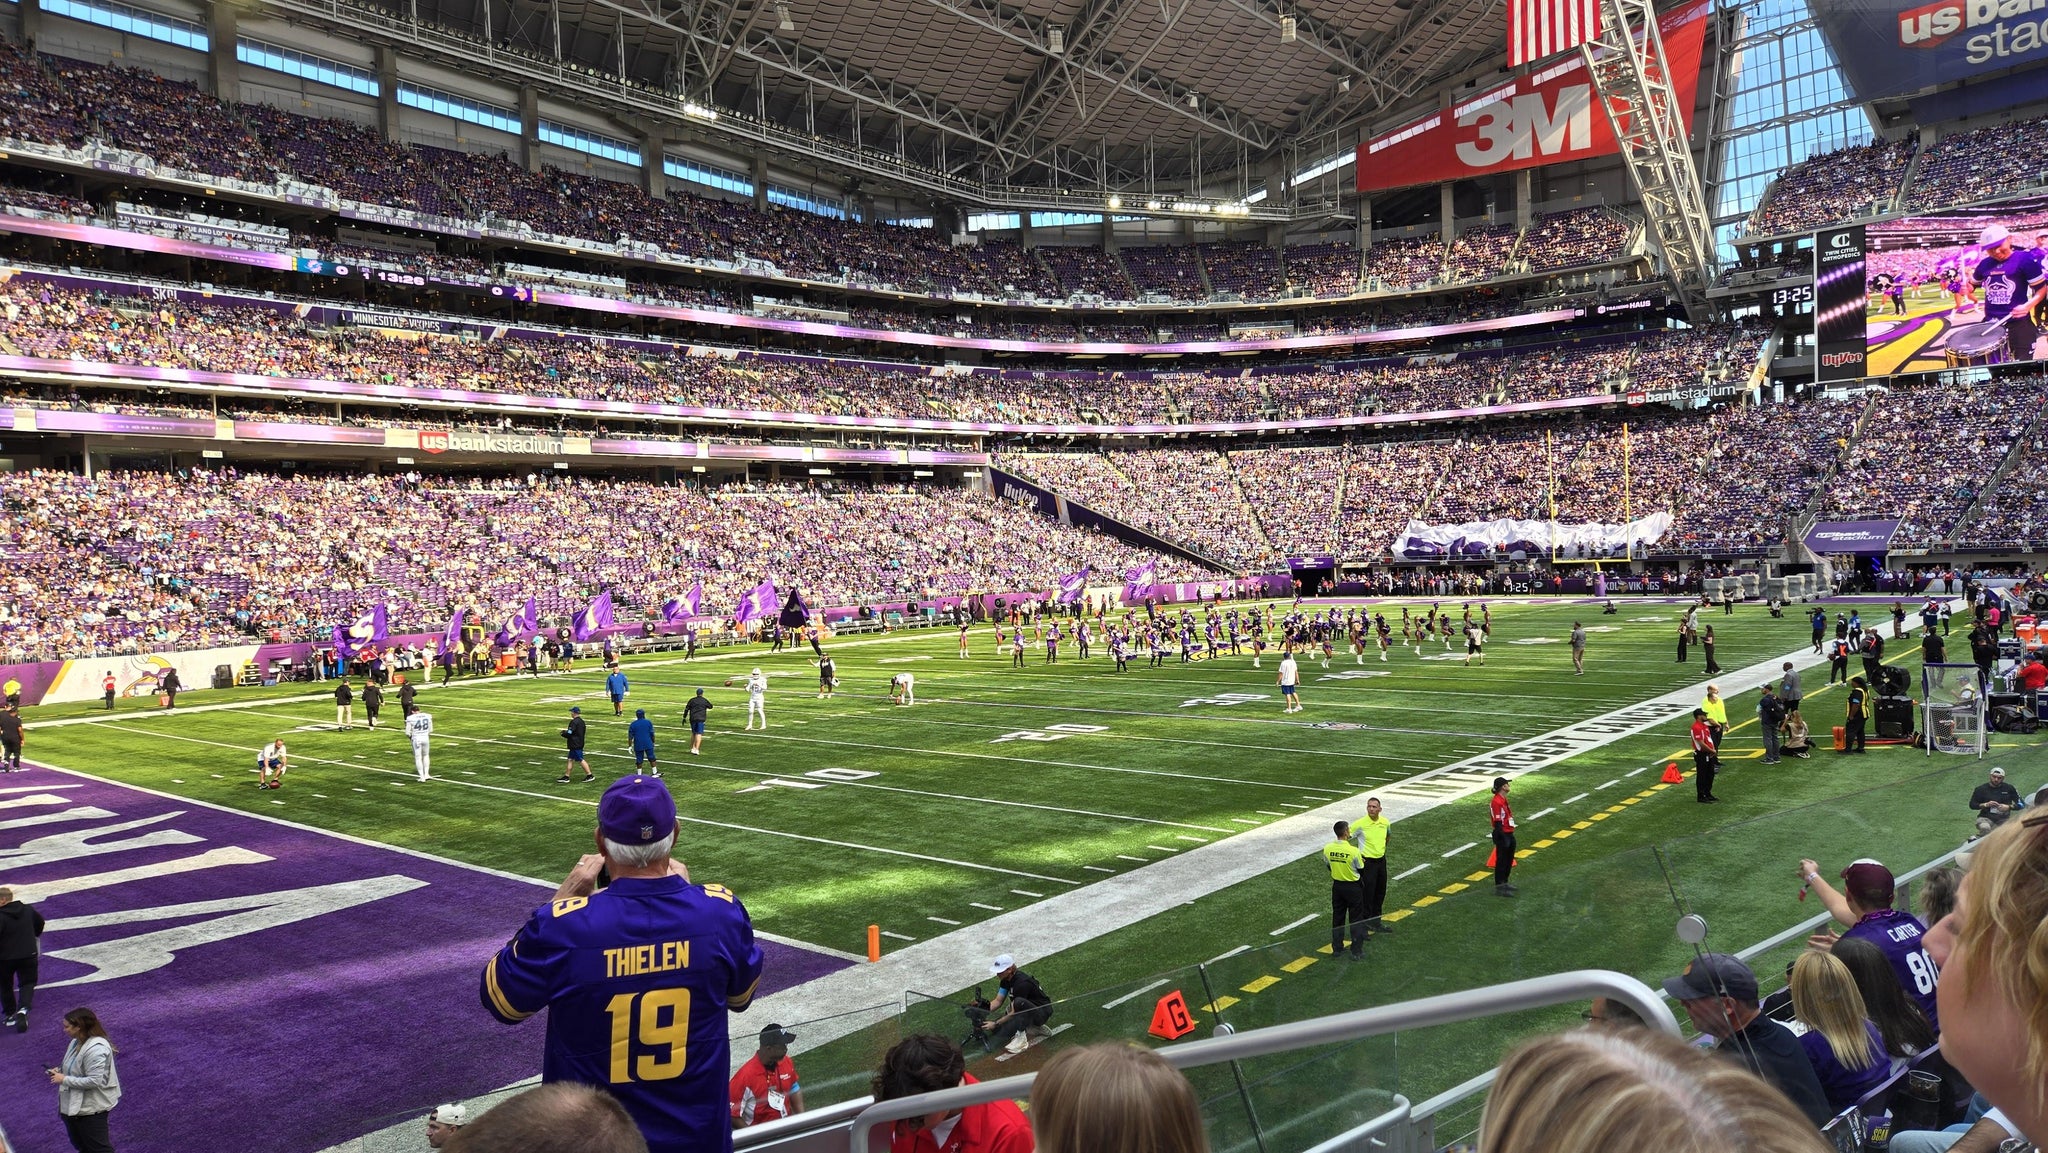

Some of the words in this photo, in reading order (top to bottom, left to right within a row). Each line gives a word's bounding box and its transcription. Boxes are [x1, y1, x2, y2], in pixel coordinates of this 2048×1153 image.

[1455, 83, 1592, 167] 3M
[109, 163, 131, 174] KRAUSE
[355, 212, 387, 224] MINNESOTA
[389, 217, 412, 228] VIKINGS
[427, 224, 441, 232] RING
[1822, 252, 1861, 262] ORTHOPEDICS
[335, 265, 349, 275] 0
[362, 272, 371, 280] 1
[378, 272, 425, 286] 13:26
[491, 286, 504, 296] 0
[1773, 286, 1812, 304] 13:25
[1629, 300, 1651, 309] HAUS
[352, 312, 397, 327] MINNESOTA
[408, 318, 440, 332] VIKINGS
[1320, 365, 1336, 373] SKOL
[414, 718, 429, 730] 48
[1384, 735, 1598, 799] INTERCEPT
[1572, 702, 1697, 734] CANCER
[1329, 851, 1350, 859] BEST
[1886, 922, 1921, 943] CARTER
[603, 940, 690, 978] THIELEN
[1166, 998, 1189, 1032] G
[605, 987, 691, 1084] 19
